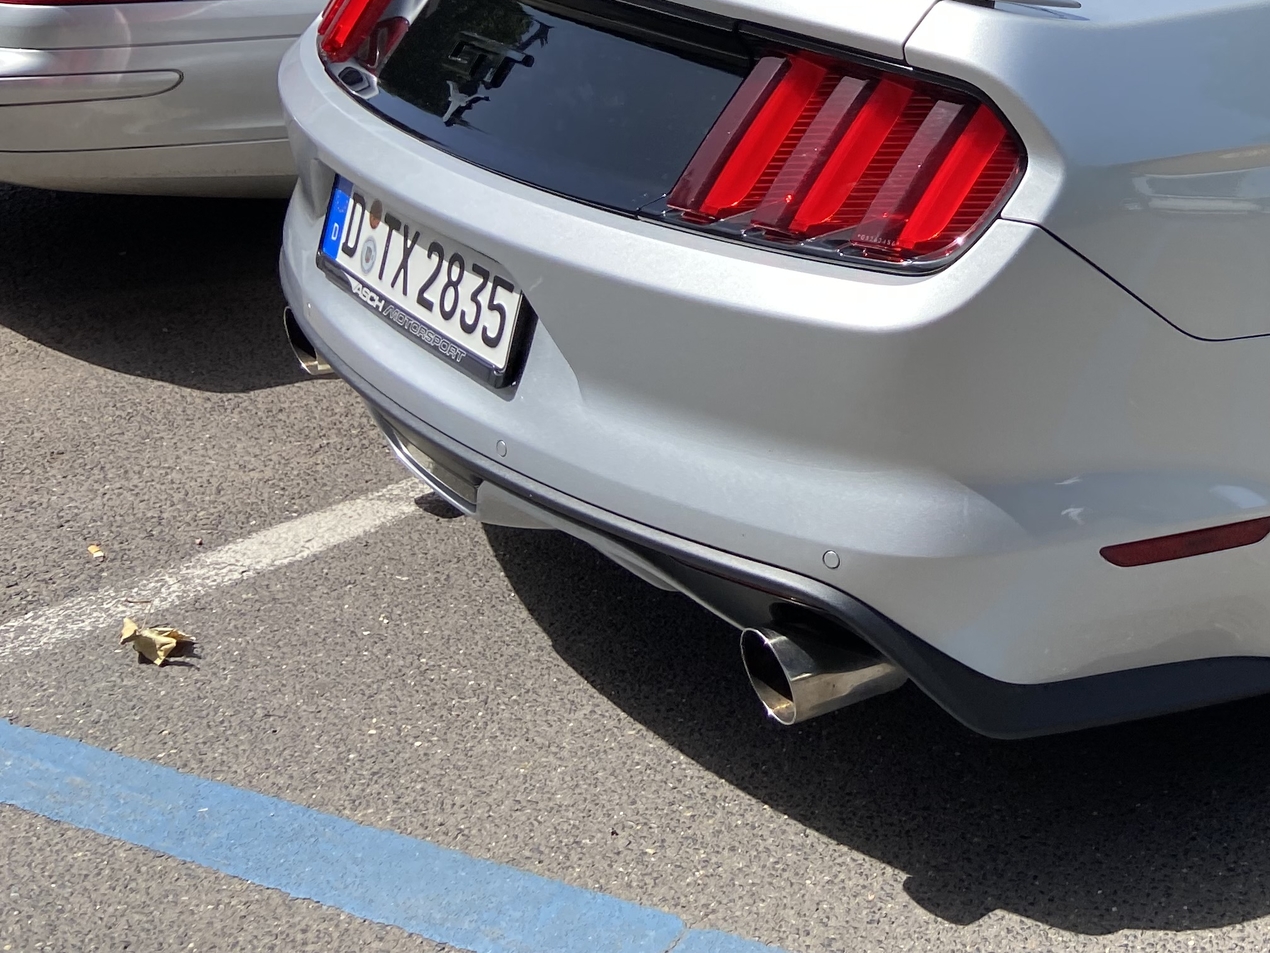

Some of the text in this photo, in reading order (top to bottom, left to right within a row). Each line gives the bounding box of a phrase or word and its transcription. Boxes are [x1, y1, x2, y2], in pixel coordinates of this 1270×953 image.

[331, 222, 340, 241] D
[341, 192, 515, 348] D TX 2835
[383, 305, 467, 363] MOTORSPORT
